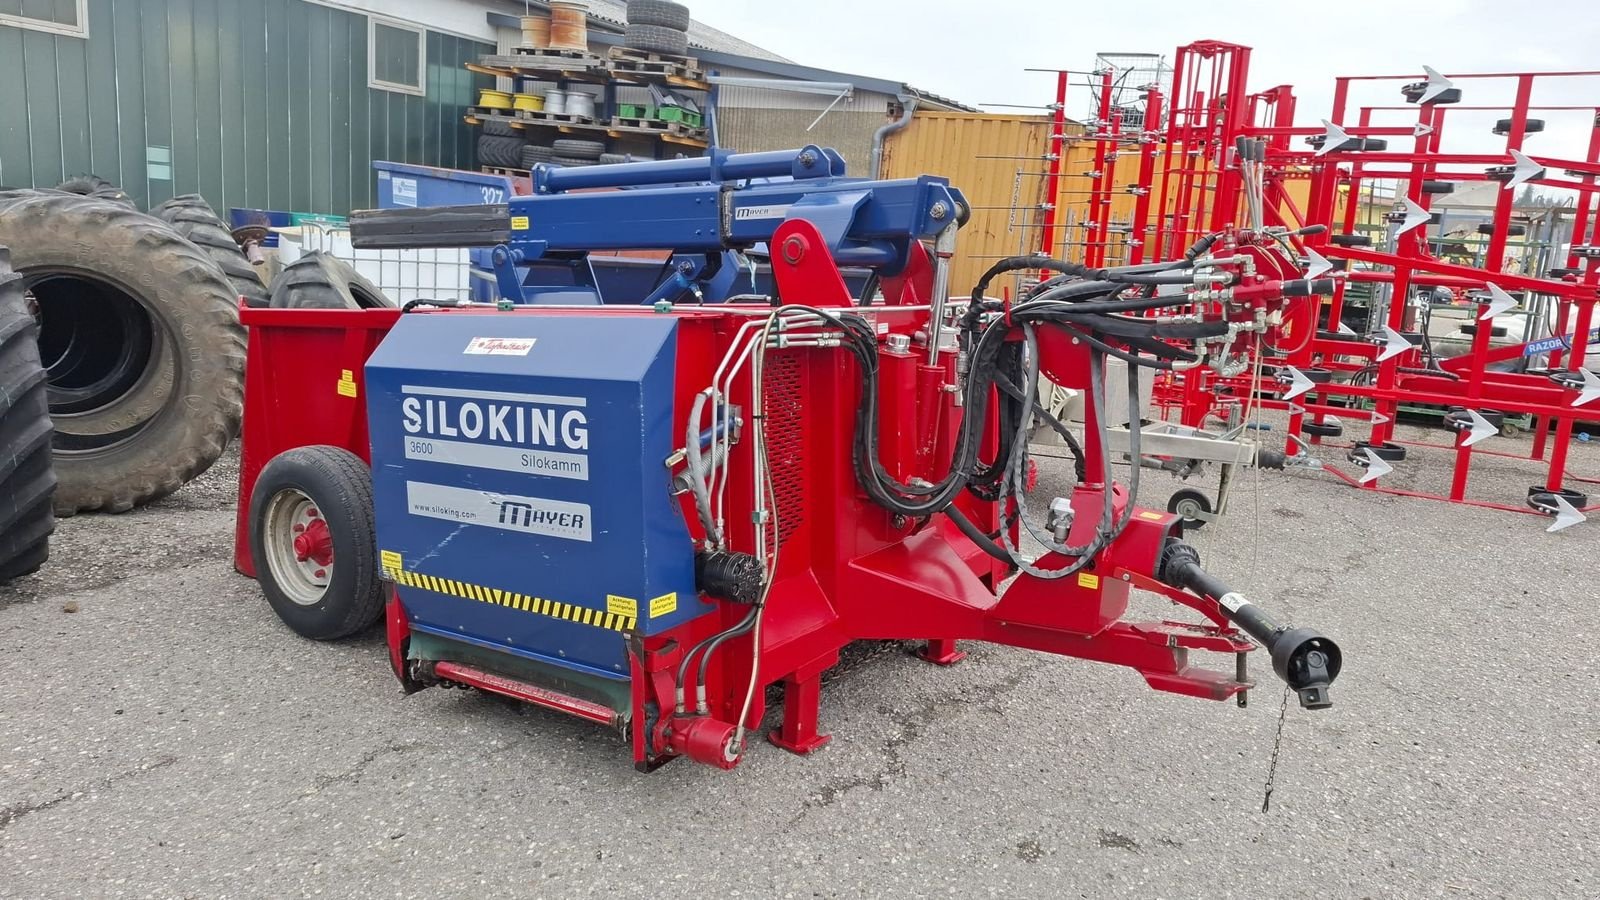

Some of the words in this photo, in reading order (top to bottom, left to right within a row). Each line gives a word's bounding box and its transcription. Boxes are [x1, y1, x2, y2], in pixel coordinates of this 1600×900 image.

[1528, 338, 1563, 353] RAZOR
[402, 397, 589, 450] SILOKING
[410, 441, 433, 455] 3600
[521, 453, 582, 472] Silokamm
[414, 503, 477, 520] www.siloking.com
[499, 501, 584, 529] MAYER
